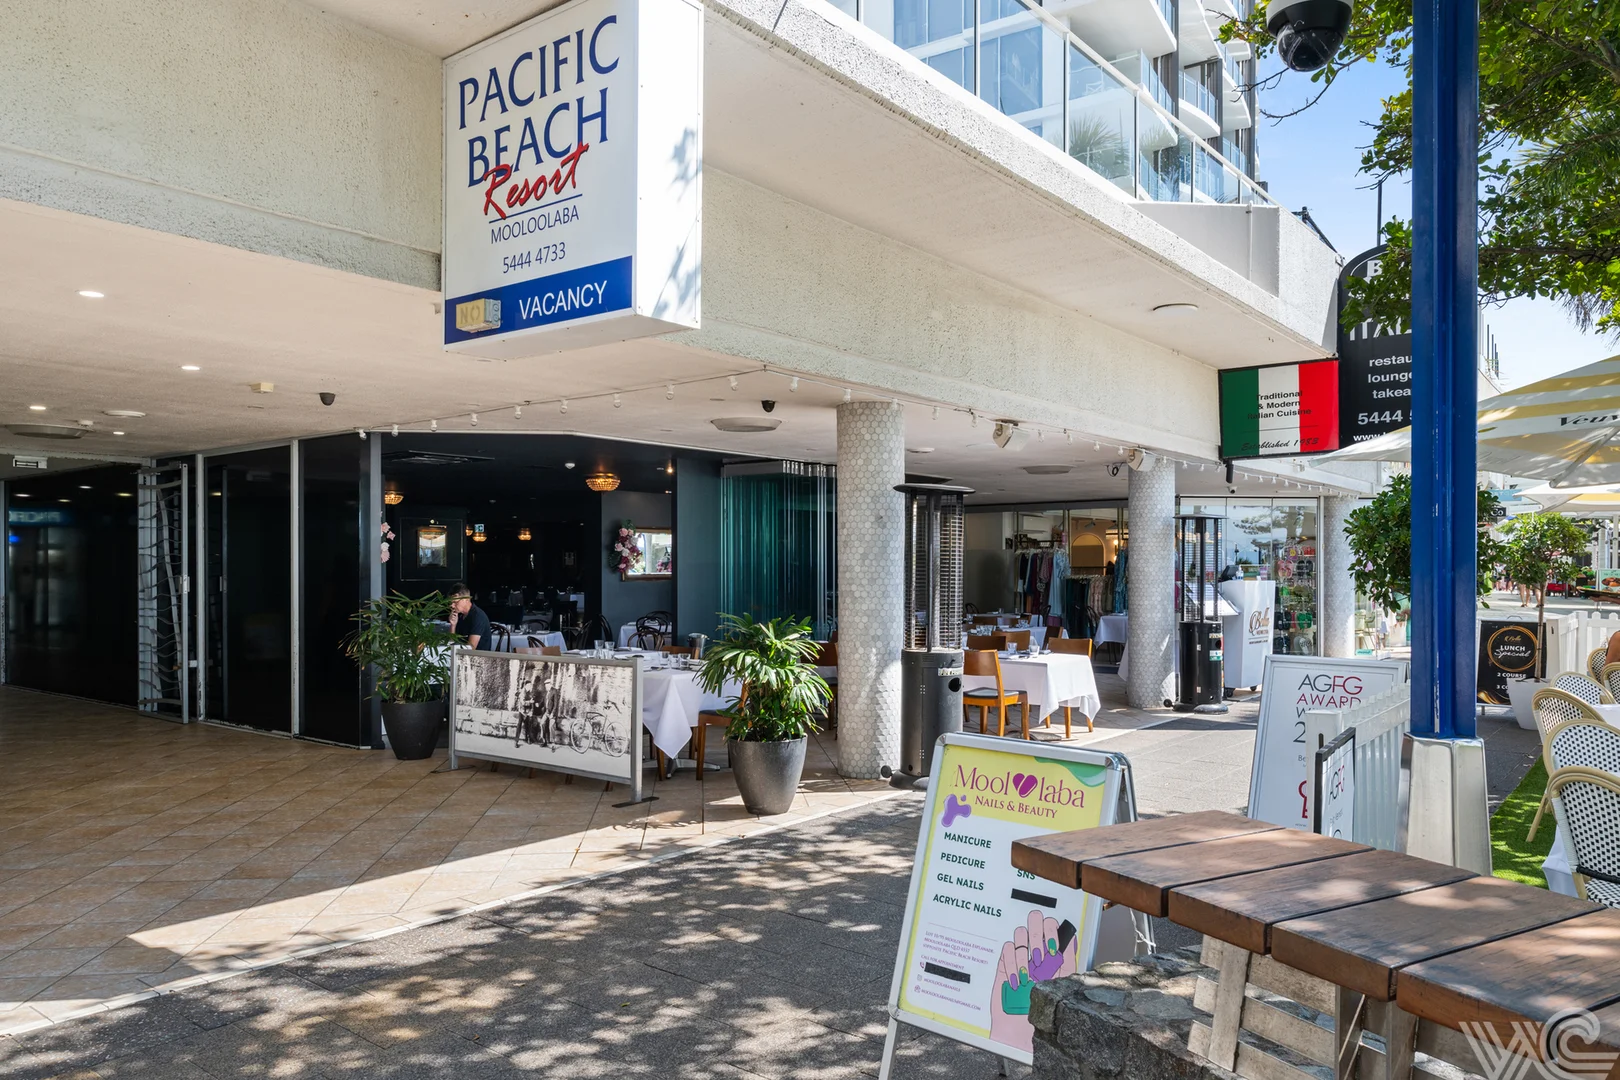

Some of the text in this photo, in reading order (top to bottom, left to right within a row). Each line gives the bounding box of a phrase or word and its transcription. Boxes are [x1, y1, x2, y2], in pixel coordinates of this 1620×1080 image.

[458, 15, 620, 130] PACIFIC
[467, 87, 608, 187] BEACH
[483, 141, 590, 219] Resort
[490, 205, 580, 244] MOOLOOLABA
[502, 242, 566, 274] 5444 4733
[460, 280, 608, 325] NO VACANCY
[1256, 390, 1303, 401] Traditional
[1247, 408, 1312, 420] Italian Cuisine
[1266, 401, 1301, 409] Modern
[1357, 410, 1404, 425] 5444
[1241, 440, 1290, 451] Established
[1494, 649, 1532, 658] Special
[1298, 674, 1363, 695] AGFG
[1007, 801, 1015, 811] &
[944, 831, 992, 849] MANICURE
[940, 852, 986, 869] PEDICURE
[937, 873, 984, 891] GEL NAILS
[933, 894, 1002, 918] ACRYLIC NAILS
